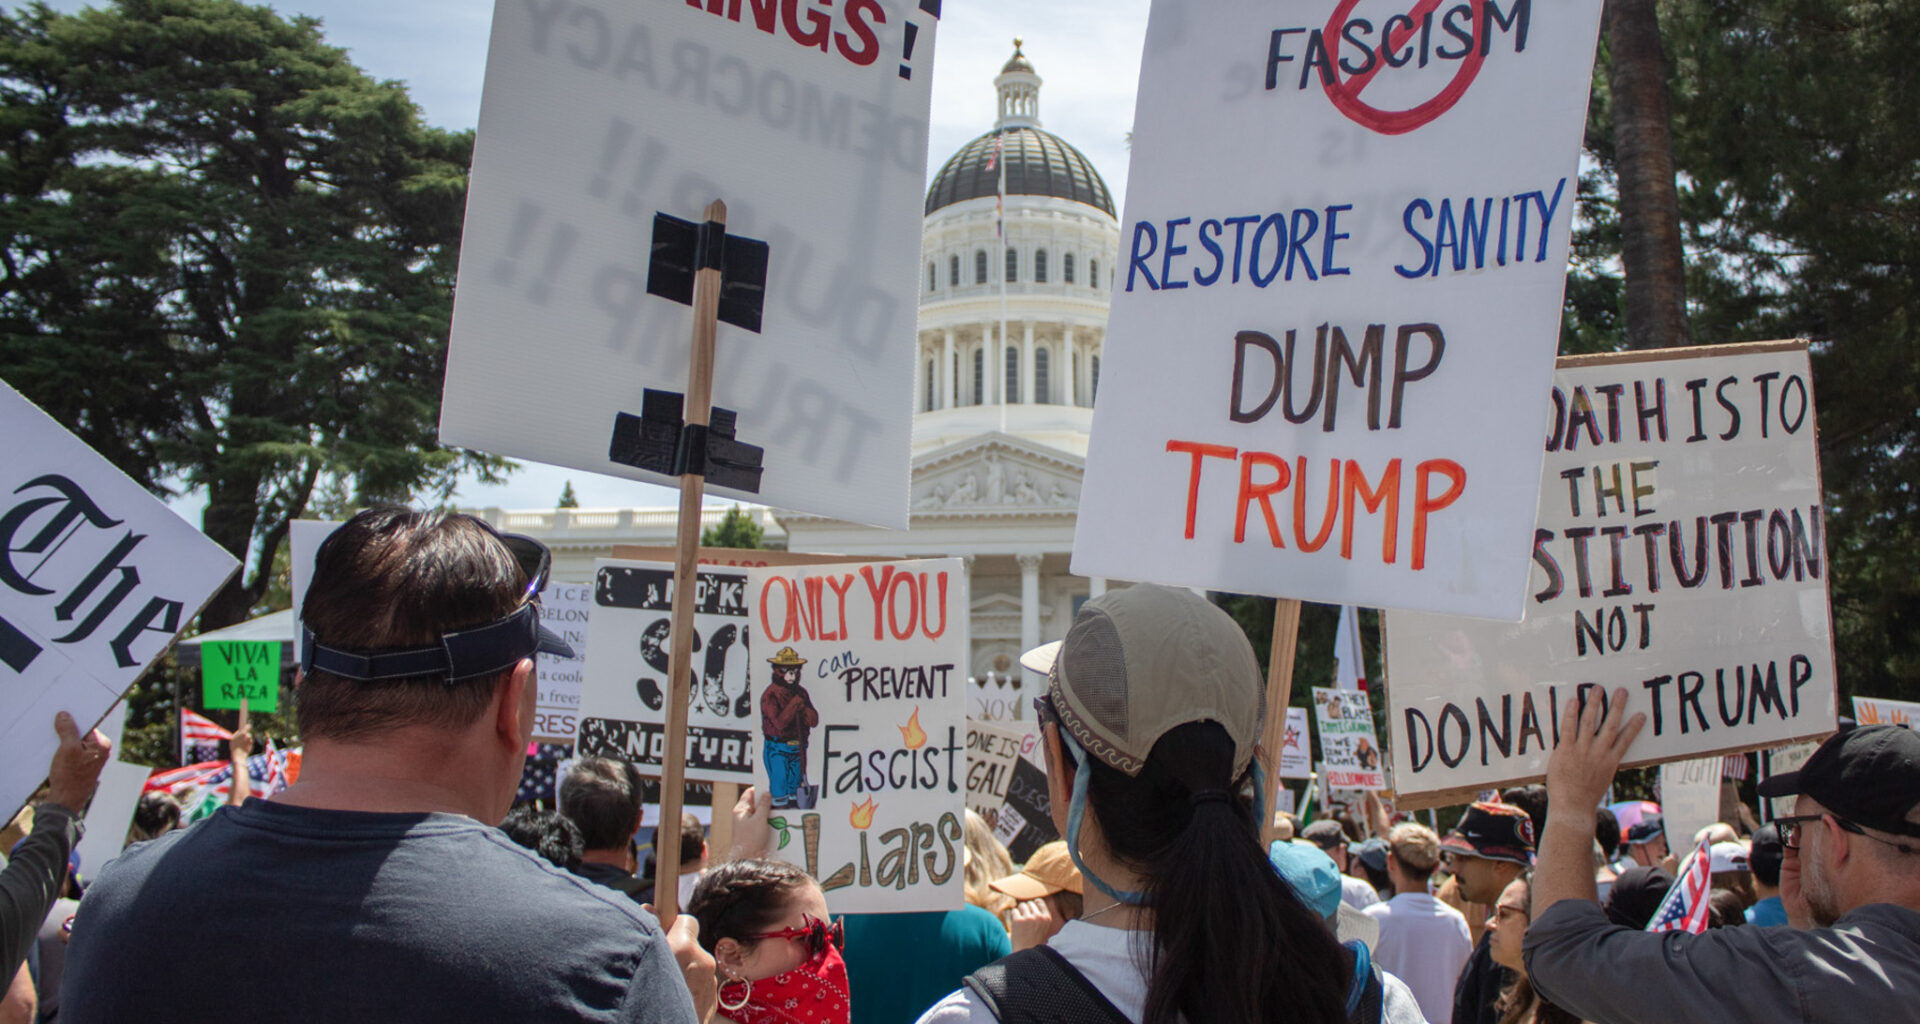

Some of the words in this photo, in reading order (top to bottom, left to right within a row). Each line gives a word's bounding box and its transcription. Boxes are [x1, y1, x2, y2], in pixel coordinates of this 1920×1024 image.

[1265, 0, 1531, 90] FASCISM
[1124, 203, 1354, 292] RESTORE
[1393, 177, 1567, 280] SANITY
[1229, 321, 1446, 432] DUMP
[1685, 375, 1741, 444] IS
[1752, 371, 1808, 439] TO
[1165, 439, 1467, 571] TRUMP
[1560, 460, 1660, 517] THE
[0, 474, 184, 668] The
[759, 573, 855, 643] ONLY
[858, 564, 949, 643] YOU
[217, 643, 269, 666] VIVA
[817, 649, 860, 679] can
[1574, 603, 1656, 657] NOT
[221, 682, 267, 699] RAZA
[234, 667, 258, 681] LA
[838, 664, 955, 702] PREVENT
[996, 737, 1020, 759] IS
[1404, 682, 1609, 774] DONALD
[1642, 654, 1813, 737] TRUMP
[821, 724, 964, 800] Fascist
[800, 811, 963, 892] Liars
